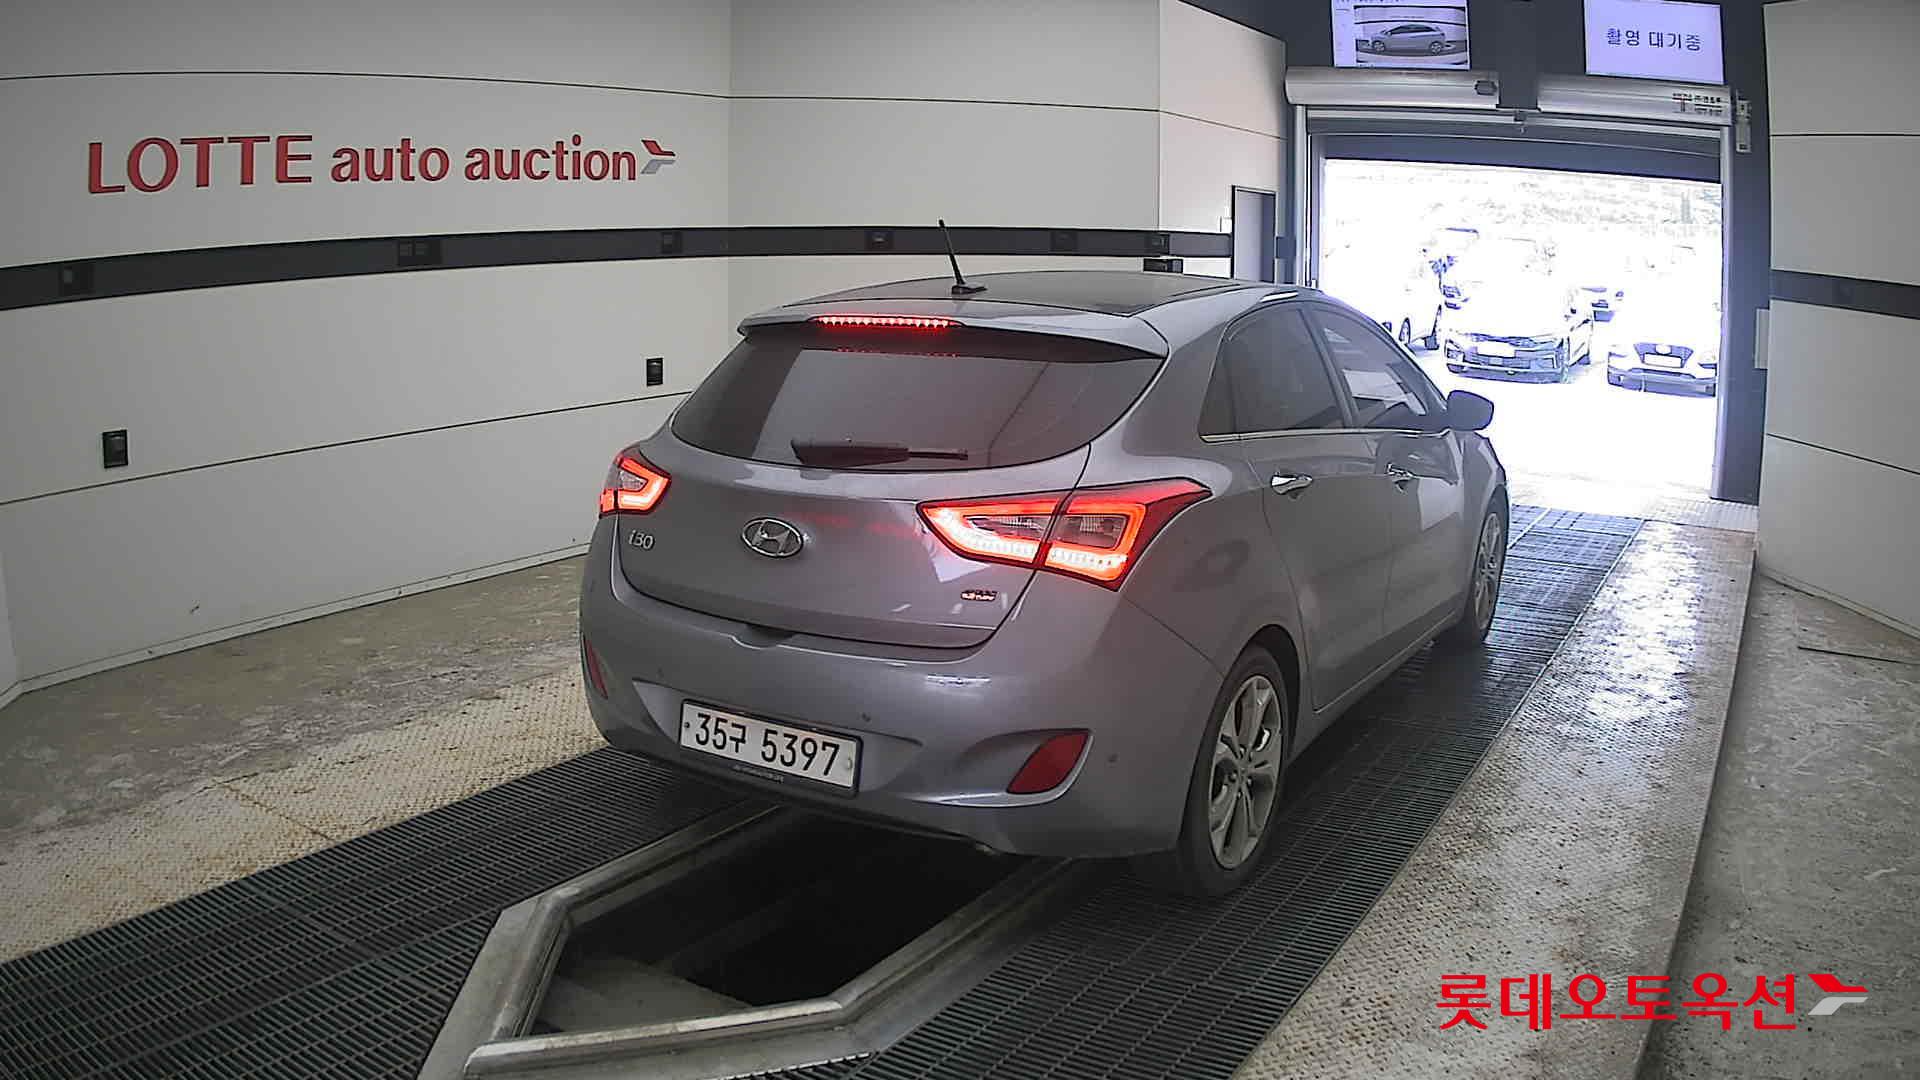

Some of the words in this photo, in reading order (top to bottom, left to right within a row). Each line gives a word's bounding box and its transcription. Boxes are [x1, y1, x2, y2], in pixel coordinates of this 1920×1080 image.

[1606, 28, 1640, 46] 촬영
[1648, 31, 1701, 51] 대기중
[88, 135, 312, 193] LOTTE
[330, 137, 449, 182] auto
[463, 134, 637, 181] auction
[628, 529, 654, 550] i30
[695, 713, 747, 753] 35구
[760, 728, 840, 776] 5397
